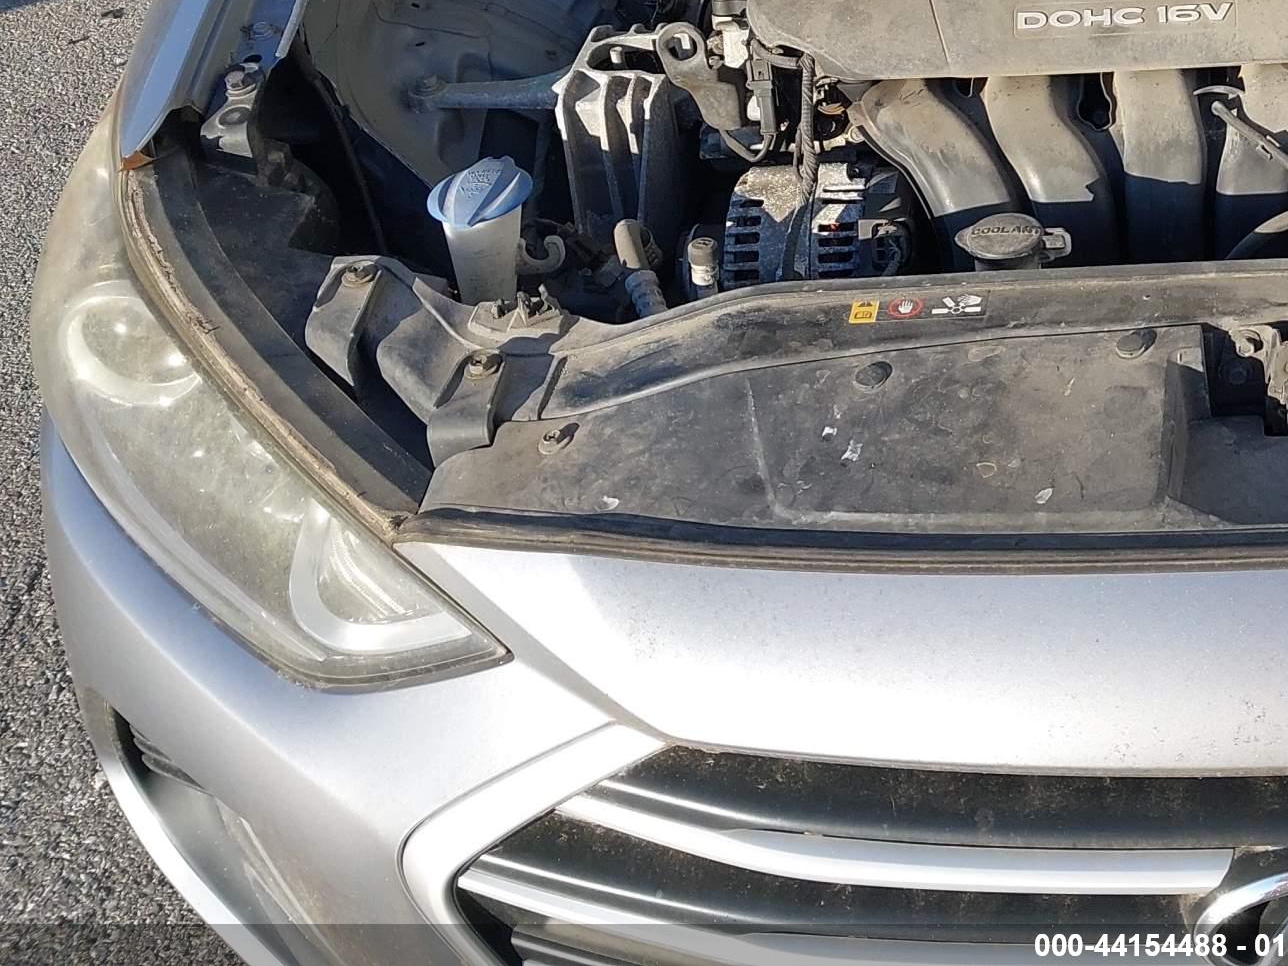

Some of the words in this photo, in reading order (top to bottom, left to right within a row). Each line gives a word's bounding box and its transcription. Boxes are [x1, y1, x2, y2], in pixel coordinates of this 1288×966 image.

[1016, 7, 1145, 30] DOHC
[1156, 1, 1234, 23] 16V
[970, 224, 1041, 236] COOLANT
